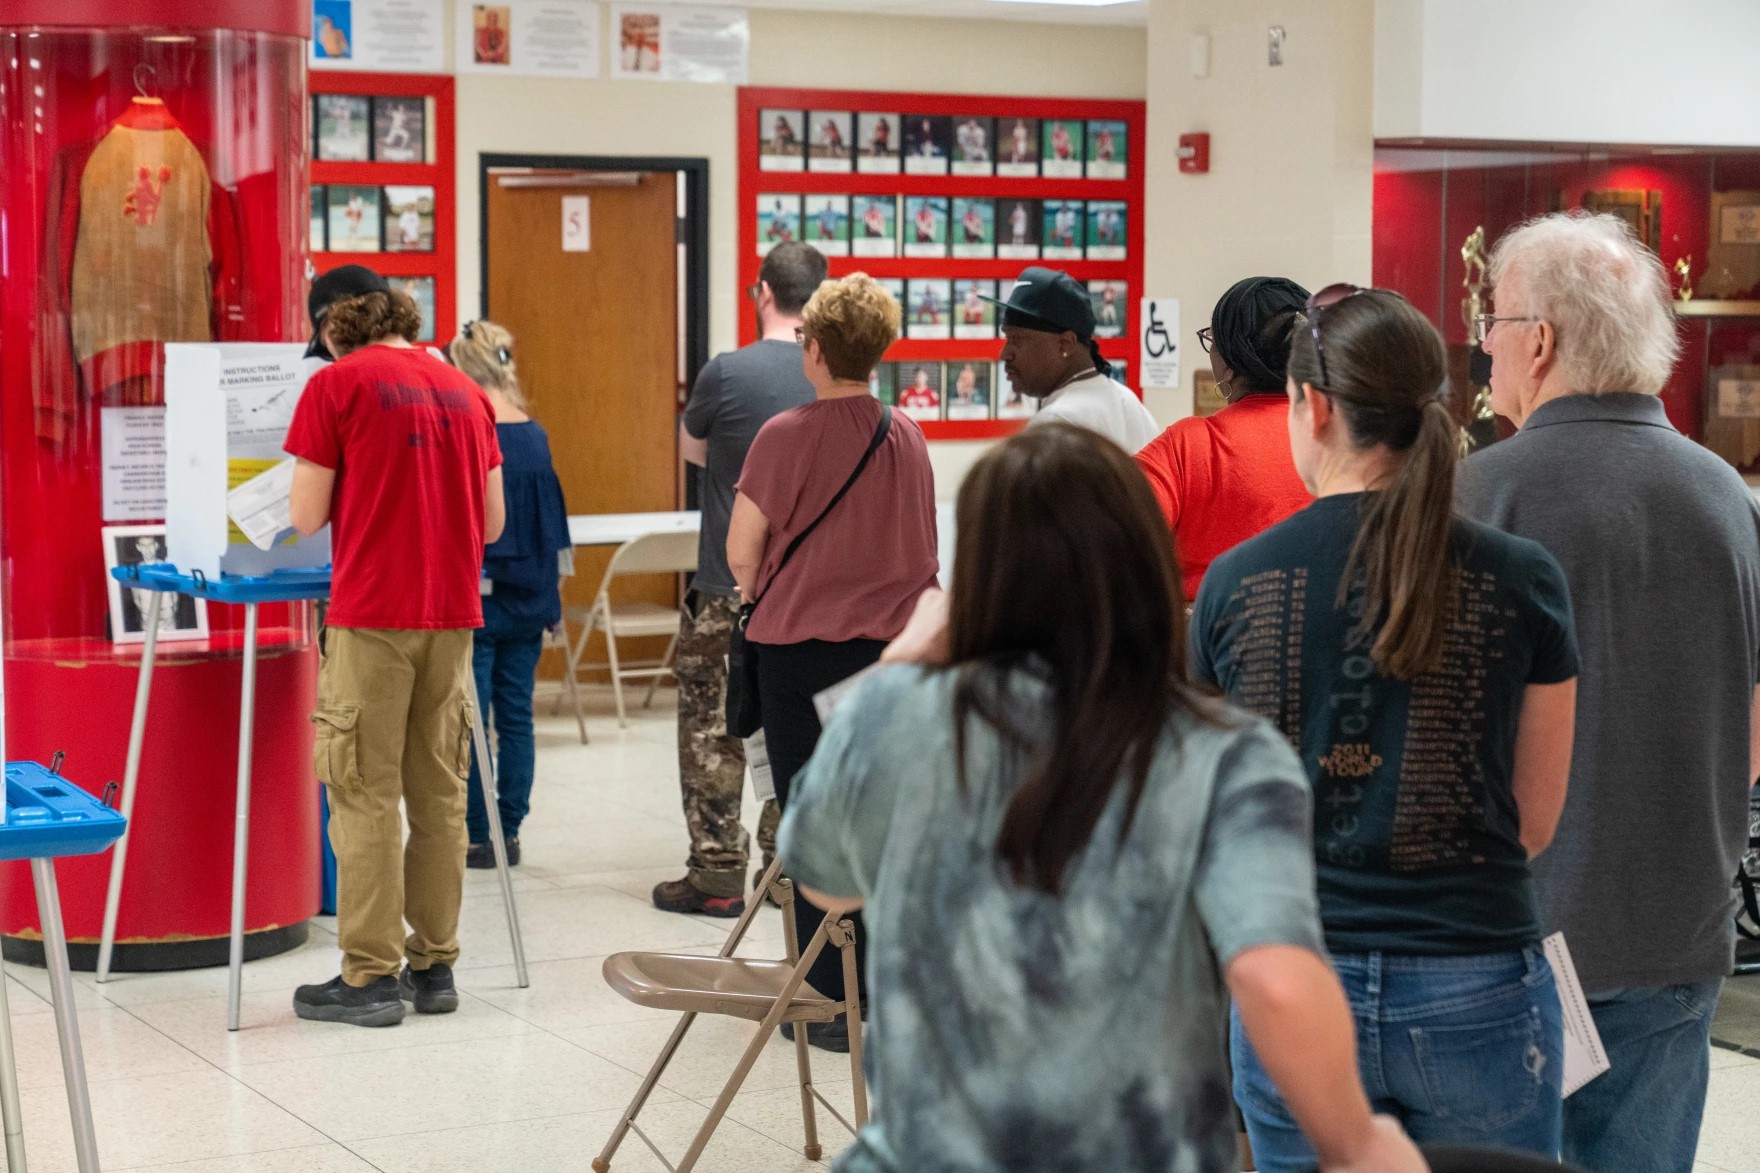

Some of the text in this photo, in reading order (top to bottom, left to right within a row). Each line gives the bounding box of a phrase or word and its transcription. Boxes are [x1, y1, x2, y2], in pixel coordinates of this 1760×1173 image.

[223, 364, 281, 376] INSTRUCTIONS
[227, 375, 265, 385] MARKING
[265, 372, 297, 383] BALLOT
